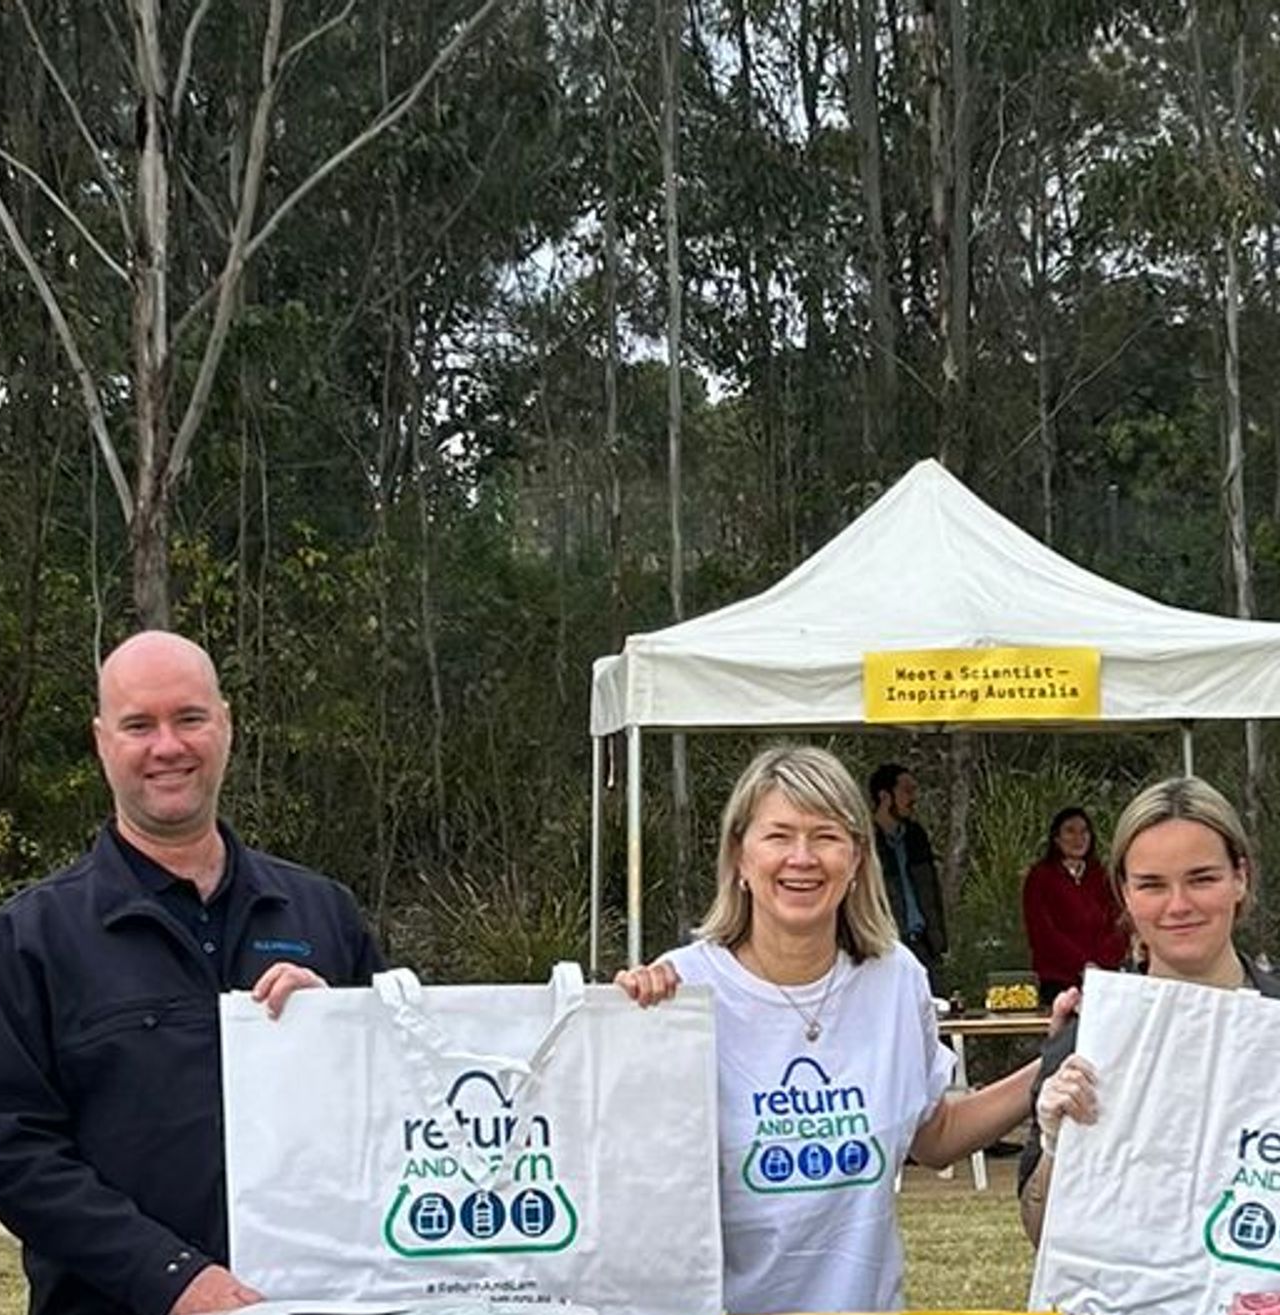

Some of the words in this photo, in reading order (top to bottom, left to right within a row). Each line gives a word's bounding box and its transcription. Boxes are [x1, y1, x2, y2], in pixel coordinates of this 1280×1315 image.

[895, 668, 937, 682] Meet
[943, 670, 954, 681] a
[959, 665, 1053, 680] Scientist
[886, 686, 979, 705] Inspiring
[985, 684, 1079, 700] Australia
[753, 1085, 866, 1116] return
[756, 1118, 794, 1136] AND
[798, 1113, 869, 1139] earn
[403, 1157, 459, 1179] AND
